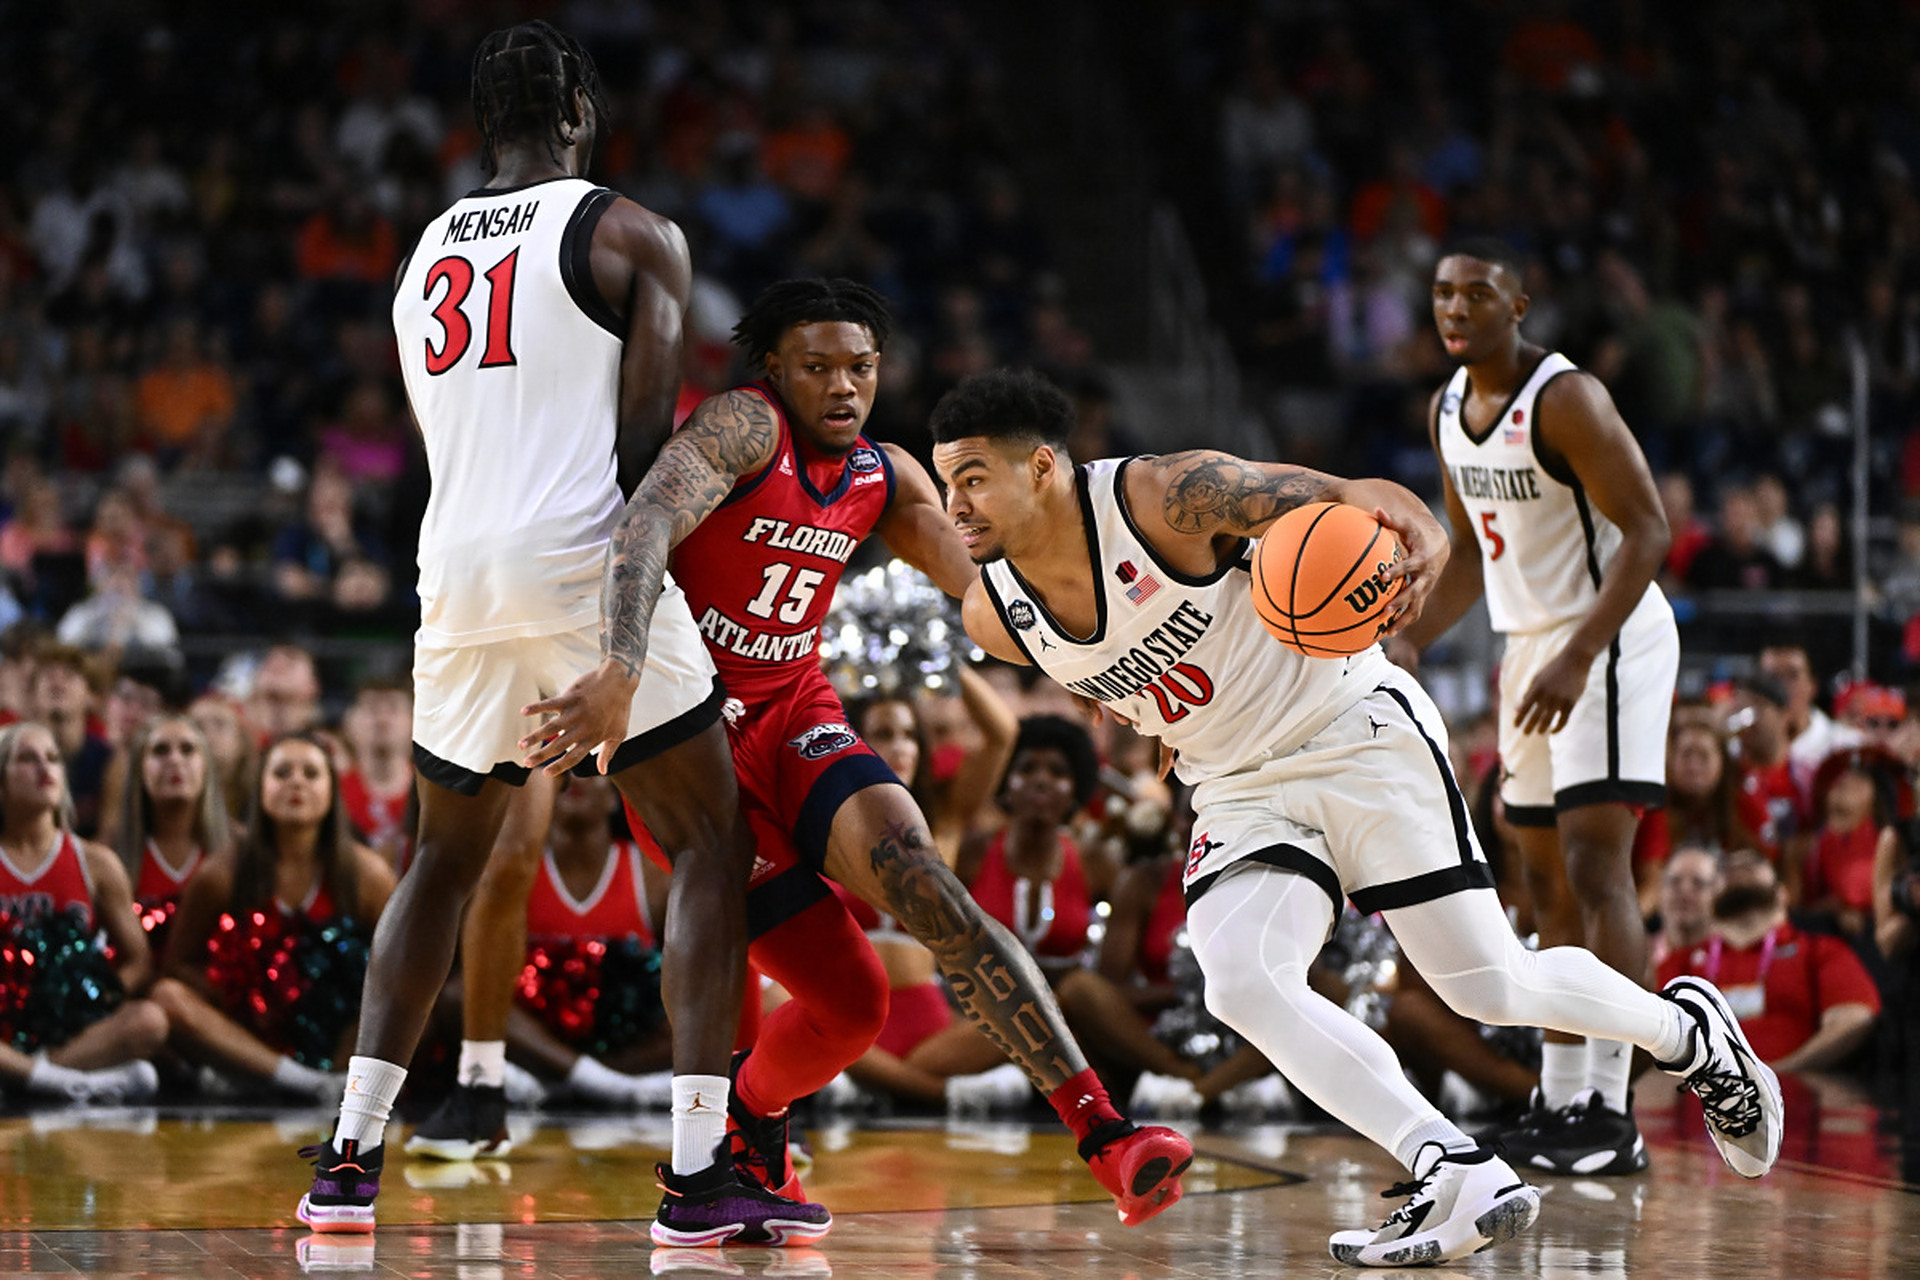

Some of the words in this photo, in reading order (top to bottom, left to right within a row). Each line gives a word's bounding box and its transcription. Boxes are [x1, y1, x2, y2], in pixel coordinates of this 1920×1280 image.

[441, 200, 540, 246] MENSAH
[423, 245, 521, 376] 31
[1492, 467, 1541, 501] STATE
[743, 517, 858, 564] FLORIDA
[1480, 511, 1505, 562] 5
[746, 561, 826, 625] 15
[699, 606, 818, 662] ATLANTIC
[1092, 648, 1163, 701] DIEGO
[1142, 600, 1213, 667] STATE
[1135, 662, 1214, 723] 20
